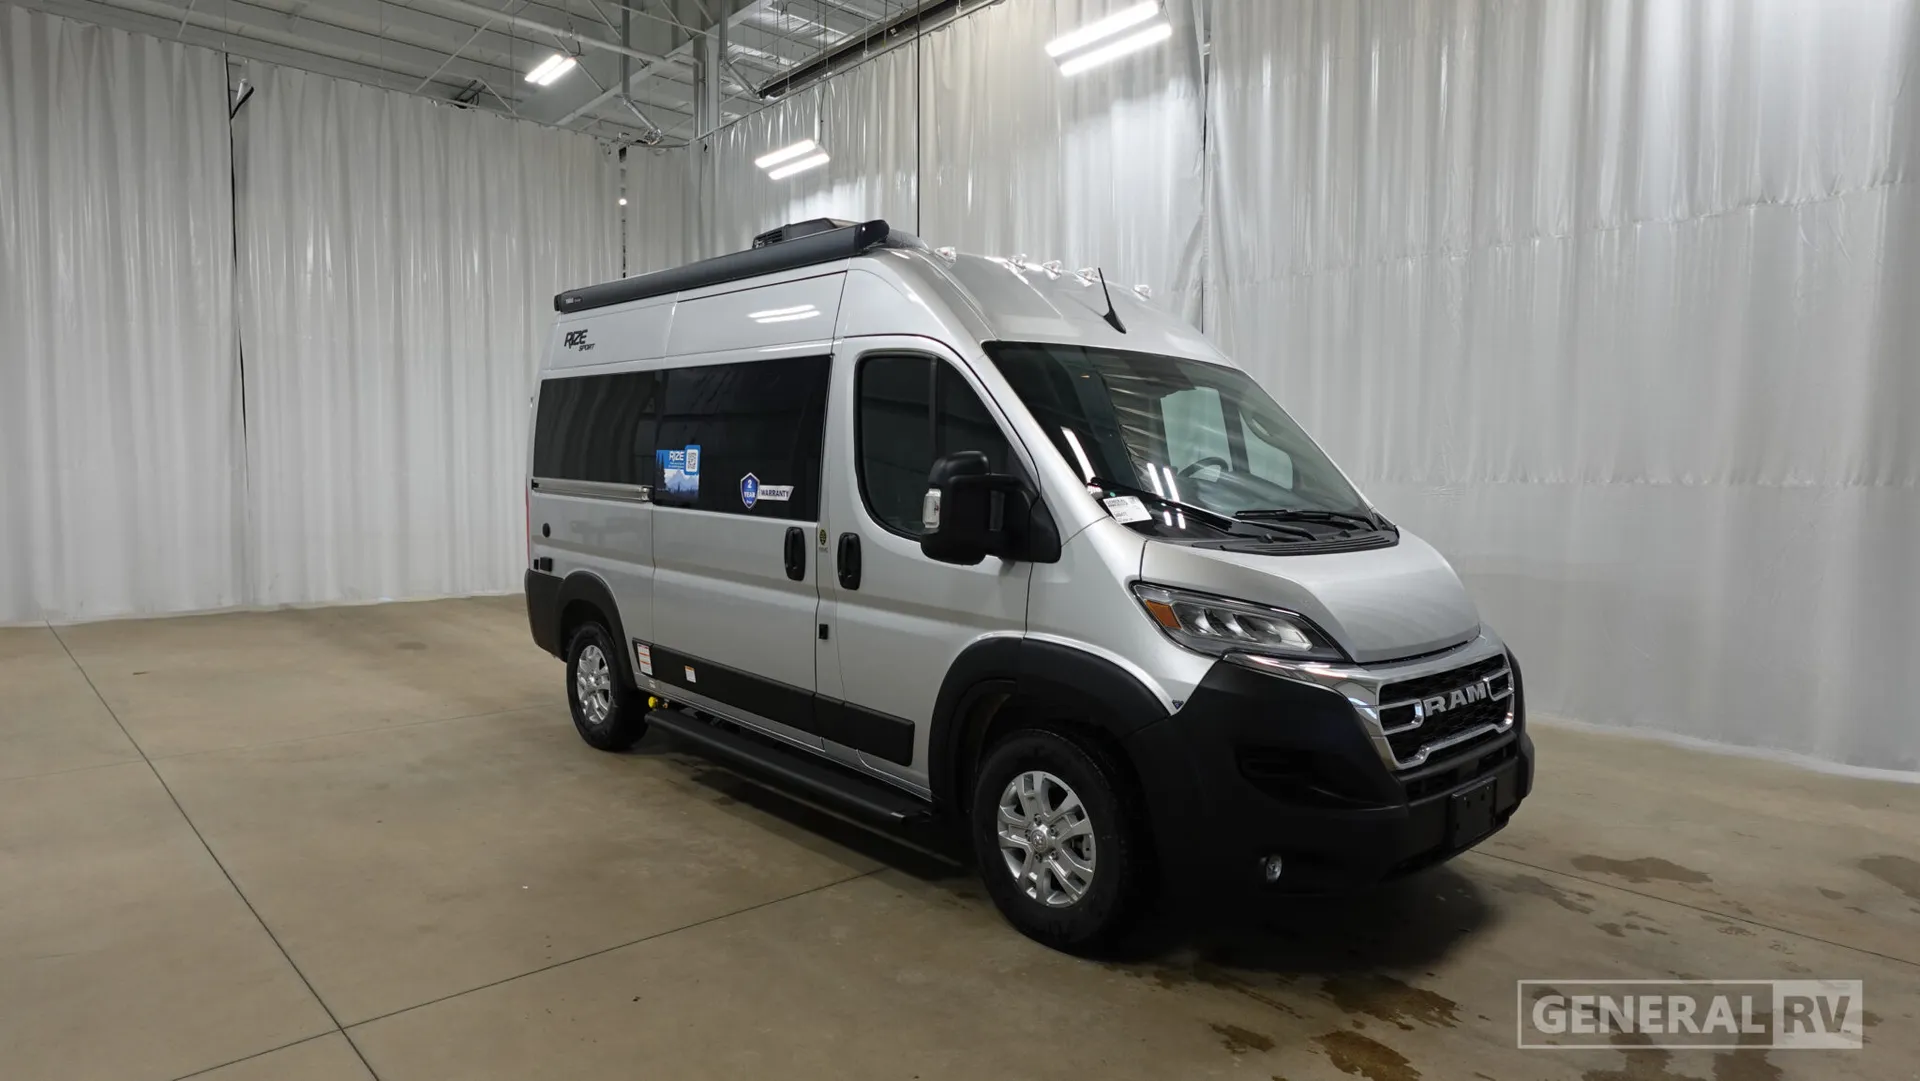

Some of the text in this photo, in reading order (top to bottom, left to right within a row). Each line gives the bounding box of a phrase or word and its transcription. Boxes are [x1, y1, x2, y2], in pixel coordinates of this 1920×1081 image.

[564, 329, 588, 349] RIZE
[578, 343, 596, 352] SPORT
[669, 450, 685, 462] RIZE
[747, 479, 753, 489] 2
[760, 489, 790, 498] WARRANTY
[1423, 682, 1487, 717] RAM
